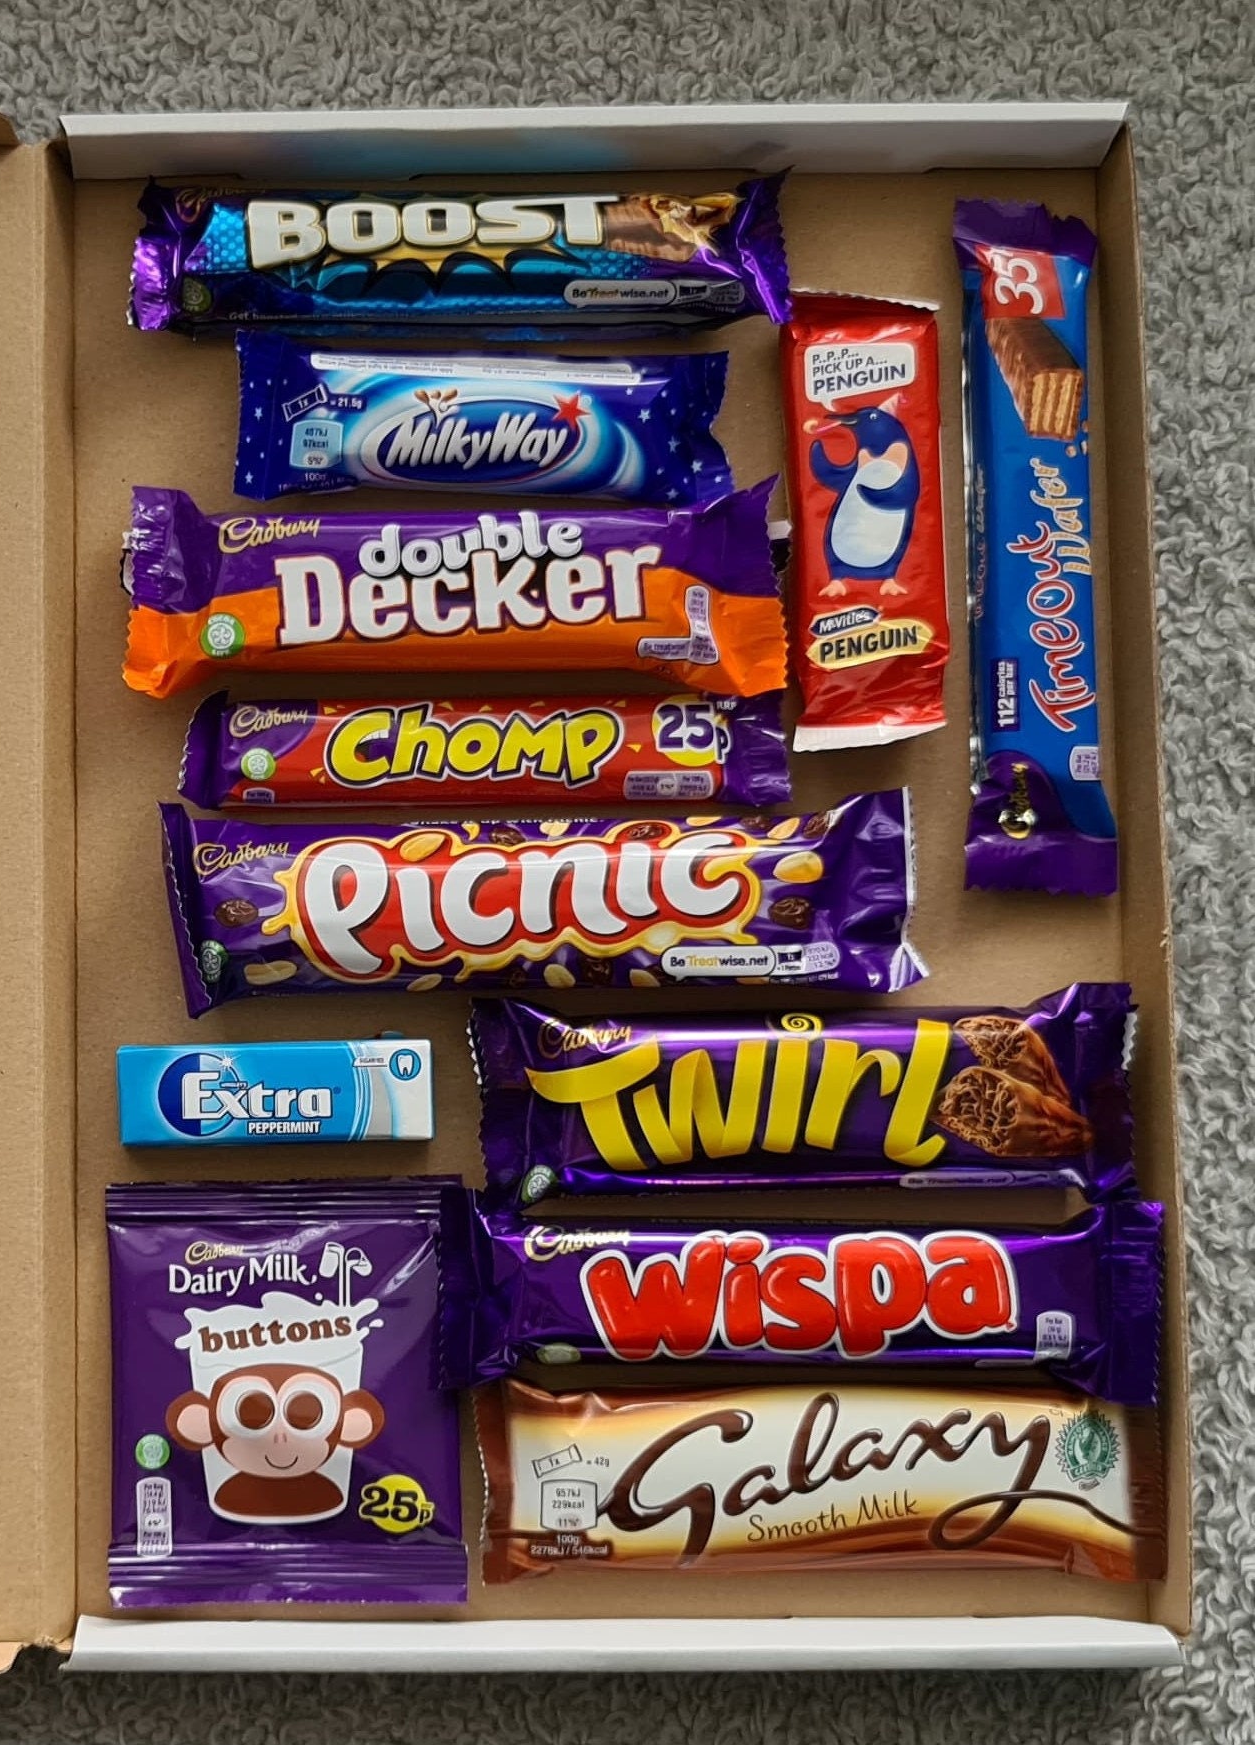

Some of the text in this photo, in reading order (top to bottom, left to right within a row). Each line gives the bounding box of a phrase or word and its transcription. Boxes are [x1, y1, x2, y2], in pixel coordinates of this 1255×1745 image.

[248, 196, 620, 269] BOOST
[812, 361, 842, 378] PICK
[845, 357, 864, 371] UP
[813, 363, 906, 396] PENGUIN
[219, 510, 583, 578] Cadbury double
[275, 544, 662, 646] Decker
[819, 625, 918, 664] PENGUIN
[229, 705, 308, 738] Cadbury
[657, 703, 731, 764] 25p
[997, 697, 1016, 728] 112
[193, 842, 289, 876] Cadbury
[297, 830, 743, 974] Picnic
[181, 1071, 333, 1120] Extra
[524, 1012, 954, 1171] Twirl
[248, 1121, 320, 1135] PEPPERMINT
[168, 1263, 245, 1297] Dairy
[198, 1315, 352, 1353] buttons
[597, 1391, 1051, 1568] Galaxy
[360, 1485, 431, 1524] 25p
[747, 1491, 919, 1543] Smooth Milk
